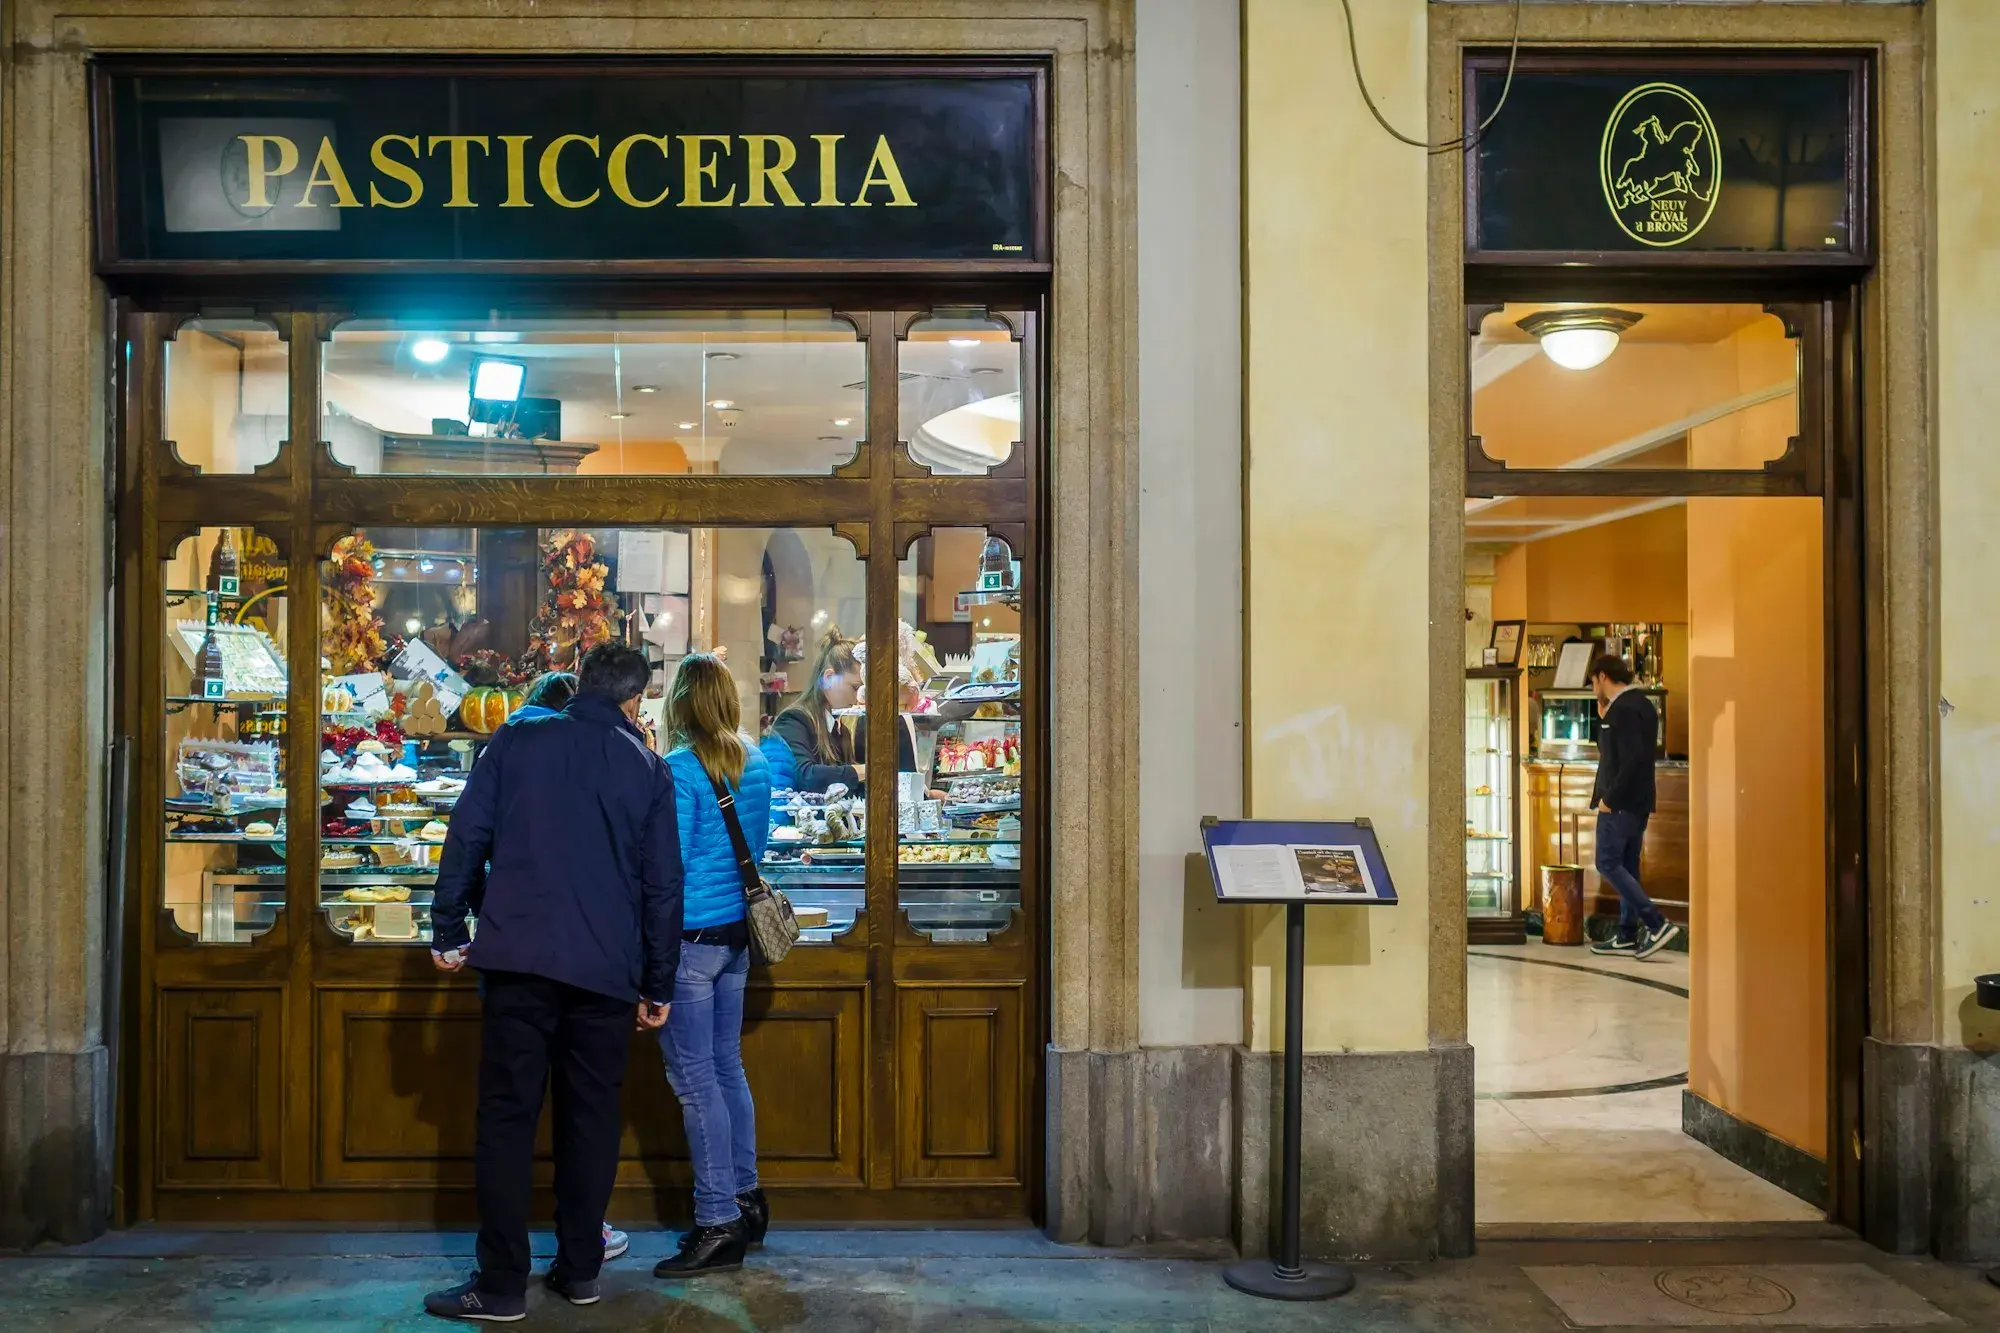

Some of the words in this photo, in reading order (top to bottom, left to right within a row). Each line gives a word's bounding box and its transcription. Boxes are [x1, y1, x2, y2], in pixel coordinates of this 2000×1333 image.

[236, 133, 918, 209] PASTICCERIA
[1650, 199, 1687, 210] NEUV
[1650, 210, 1688, 221] CAVAL
[1646, 221, 1688, 232] BRONS
